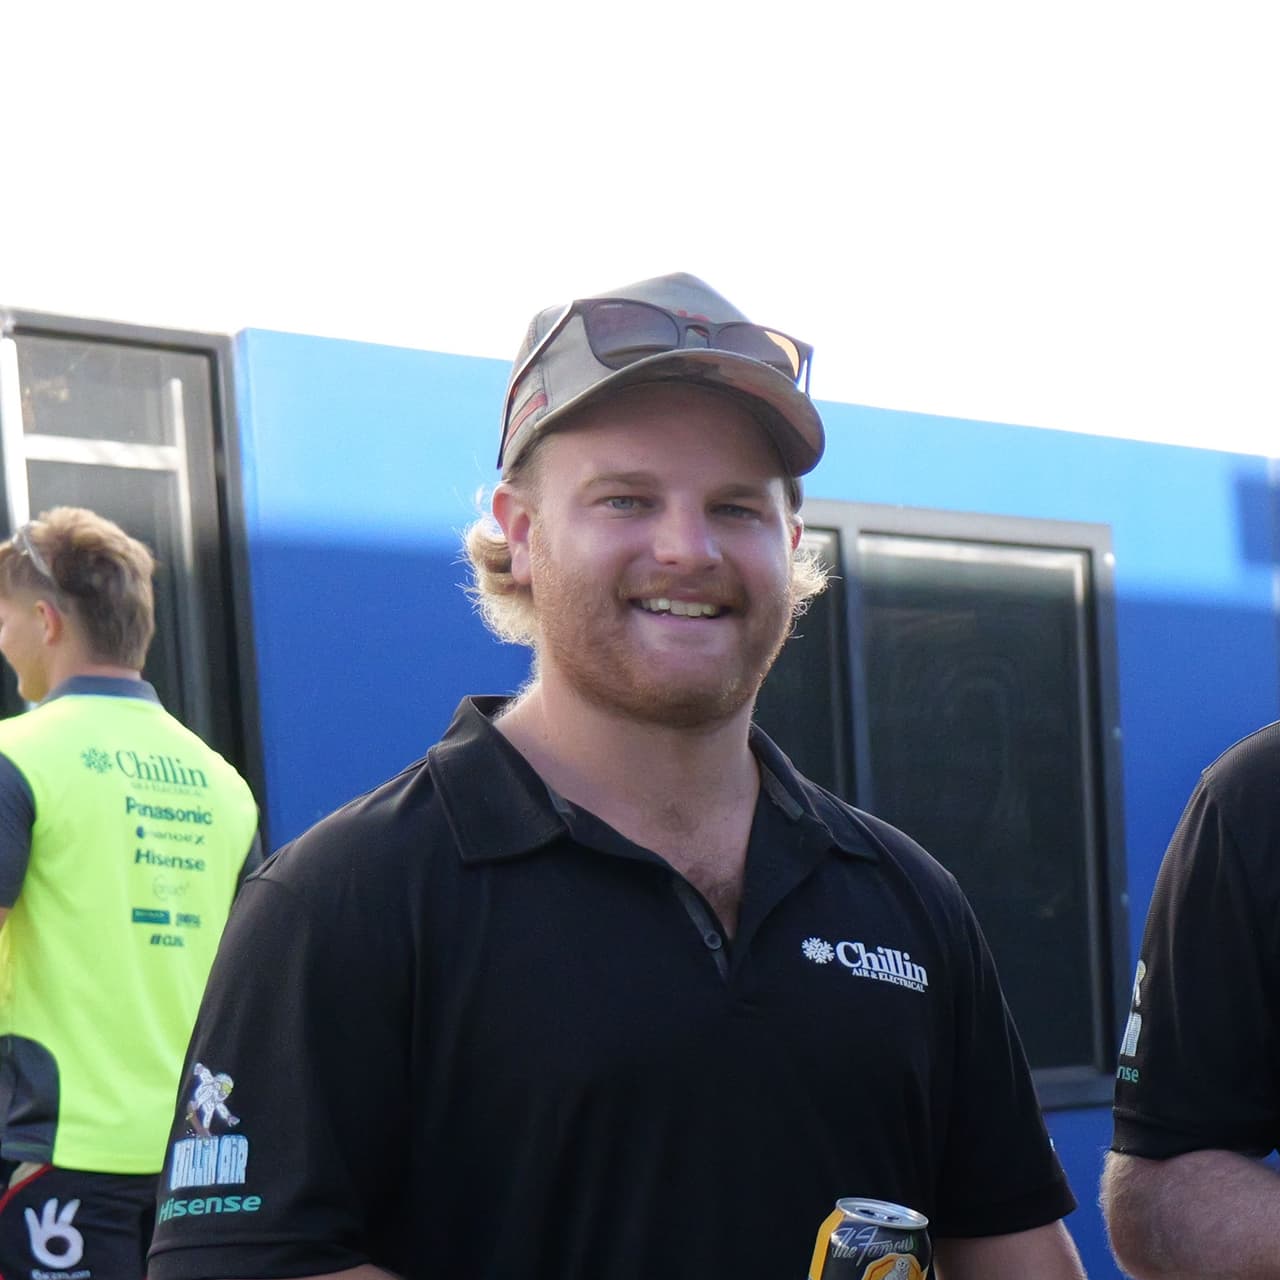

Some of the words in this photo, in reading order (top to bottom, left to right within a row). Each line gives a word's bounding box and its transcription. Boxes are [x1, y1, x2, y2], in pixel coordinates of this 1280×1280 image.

[115, 750, 208, 788] Chillin
[126, 796, 212, 825] Panasonic
[134, 848, 205, 873] Hisense
[835, 941, 929, 986] Chillin
[852, 967, 868, 978] AIR
[870, 972, 878, 980] &
[878, 972, 926, 992] ELECTRICAL
[159, 1195, 262, 1225] Hisense
